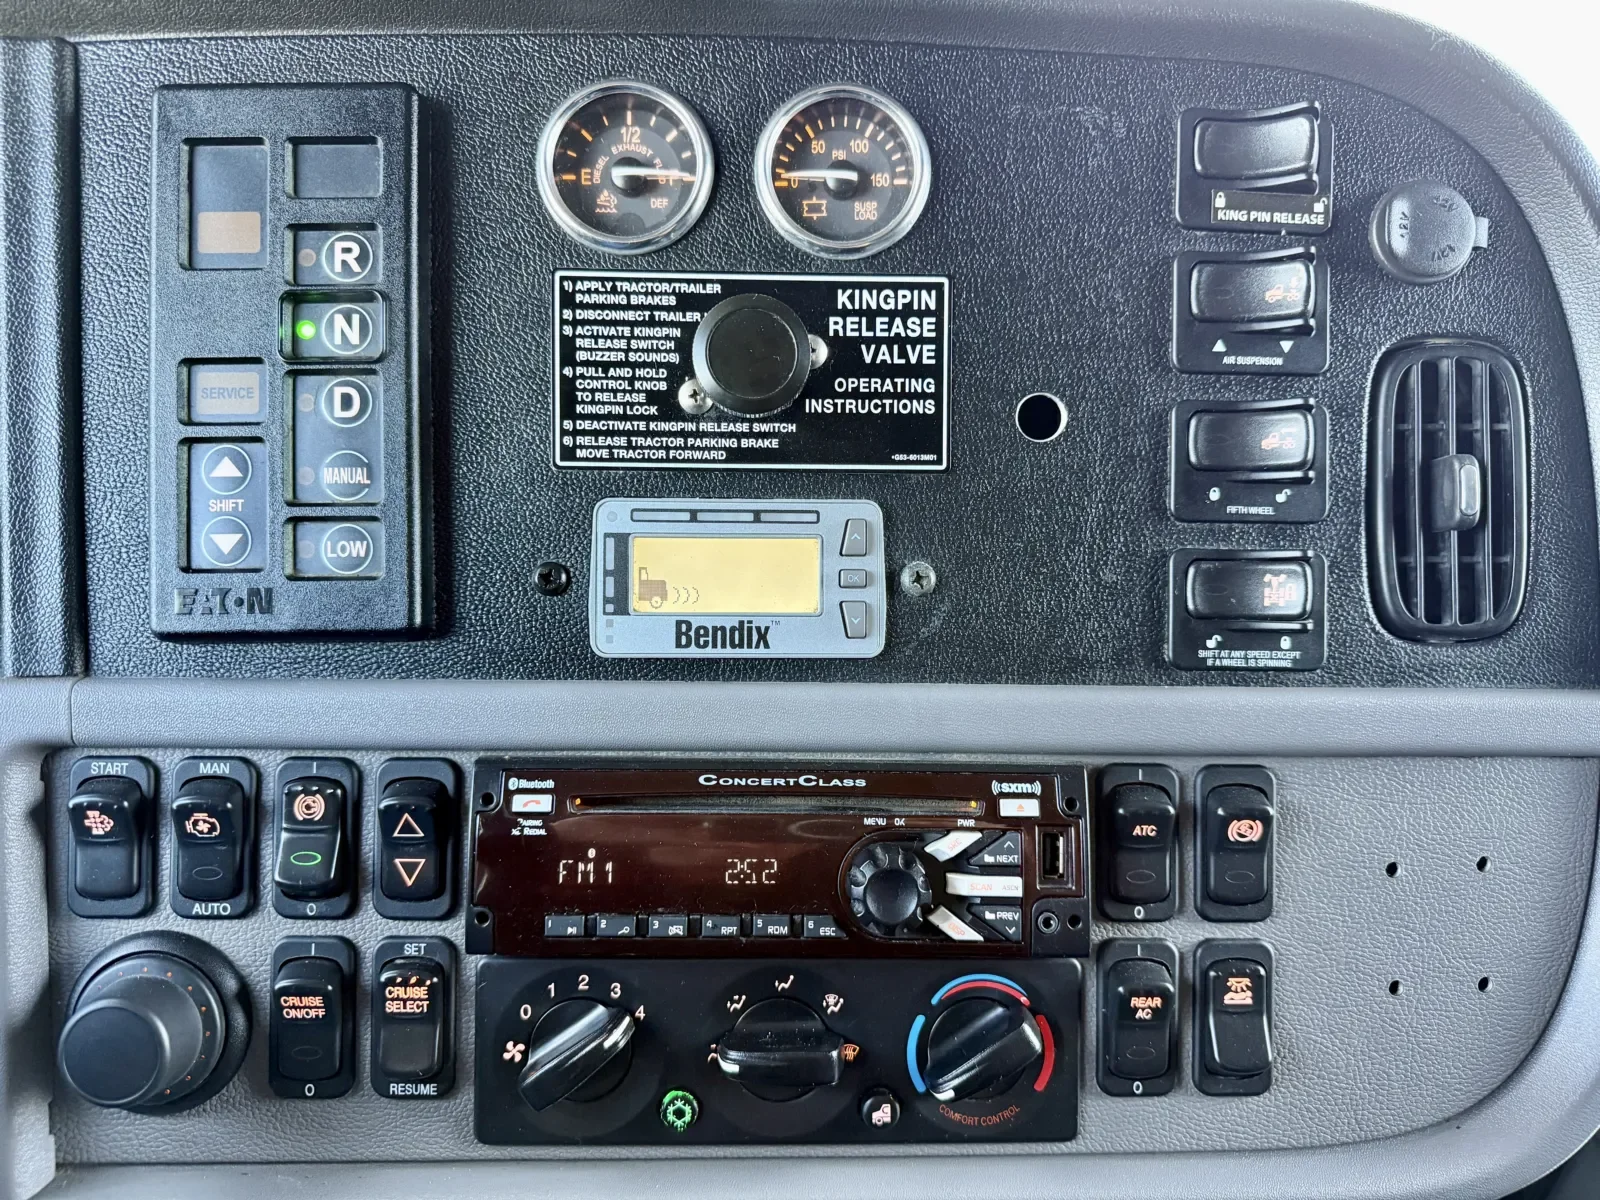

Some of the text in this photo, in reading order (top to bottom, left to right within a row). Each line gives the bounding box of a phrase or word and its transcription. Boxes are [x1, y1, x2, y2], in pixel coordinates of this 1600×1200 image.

[621, 127, 641, 143] 1/2
[811, 140, 869, 154] 50 100
[832, 150, 846, 160] PSI
[593, 155, 610, 184] DIESEL
[611, 143, 654, 158] EXHAUST
[581, 168, 592, 185] E
[870, 174, 890, 187] 150
[650, 198, 669, 209] DEF
[854, 202, 878, 212] SUSP
[854, 211, 878, 220] LOAD
[1217, 209, 1325, 225] KING PIN RELEASE
[334, 241, 362, 273] R
[562, 281, 721, 294] 1) APPLY TRACTOR/TRAILER
[576, 293, 677, 306] PARKING BRAKES
[837, 289, 936, 310] KINGPIN
[562, 310, 573, 321] 2)
[576, 310, 650, 322] DISCONNECT
[653, 311, 701, 322] TRAILER
[333, 313, 361, 345] N
[562, 326, 681, 338] 3) ACTIVATE KINGPIN
[829, 317, 936, 337] RELEASE
[576, 339, 674, 350] RELEASE SWITCH
[576, 351, 680, 364] (BUZZER SOUNDS)
[861, 344, 936, 364] VALVE
[1222, 355, 1284, 366] AIR SUSPENSION
[562, 367, 667, 378] 4) PULL AND HOLD
[576, 379, 667, 391] CONTROL KNOB
[834, 378, 936, 393] OPERATING
[201, 387, 255, 399] SERVICE
[576, 391, 646, 403] TO RELEASE
[333, 386, 361, 418] D
[805, 398, 936, 414] INSTRUCTIONS
[576, 404, 658, 416] KINGPIN LOCK
[562, 420, 797, 433] 5) DEACTIVATE KINGPIN RELEASE SWITCH
[562, 436, 780, 449] 6) RELEASE TRACTOR PARKING BRAKE
[576, 449, 727, 460] MOVE TRACTOR FORWARD
[323, 467, 371, 485] MANUAL
[208, 499, 244, 512] SHIFT
[1226, 505, 1276, 515] FIFTH WHEEL
[326, 540, 368, 558] LOW
[847, 573, 860, 583] OK
[675, 620, 771, 650] Bendix
[1197, 649, 1301, 659] SHIFT AT ANY SPEED EXCEPT
[1206, 658, 1292, 667] IF A WHEEL IS SPINNING
[91, 763, 129, 775] START
[200, 763, 230, 774] MAN
[518, 778, 555, 789] Bluetooth
[863, 817, 906, 826] MENU OK
[957, 819, 976, 827] PWR
[1132, 825, 1158, 837] ATC
[996, 855, 1019, 863] NEXT
[725, 858, 778, 884] 2:52
[970, 883, 993, 891] SCAN
[192, 903, 231, 915] AUTO
[996, 911, 1020, 920] PREV
[600, 920, 607, 929] 2
[652, 920, 659, 929] 3
[706, 919, 713, 928] 4
[756, 919, 763, 928] 5
[808, 920, 814, 929] 6
[720, 926, 738, 935] RPT
[819, 927, 836, 936] ESC
[403, 943, 427, 955] SET
[385, 986, 429, 999] CRUISE
[520, 974, 646, 1021] 0 1 2 3 4
[280, 996, 324, 1007] CRUISE
[385, 1000, 429, 1013] SELECT
[1130, 996, 1162, 1008] REAR
[283, 1008, 326, 1019] ON/OFF
[1135, 1008, 1153, 1020] AC
[389, 1083, 438, 1095] RESUME
[939, 1104, 1021, 1126] COMFORT CONTROL
